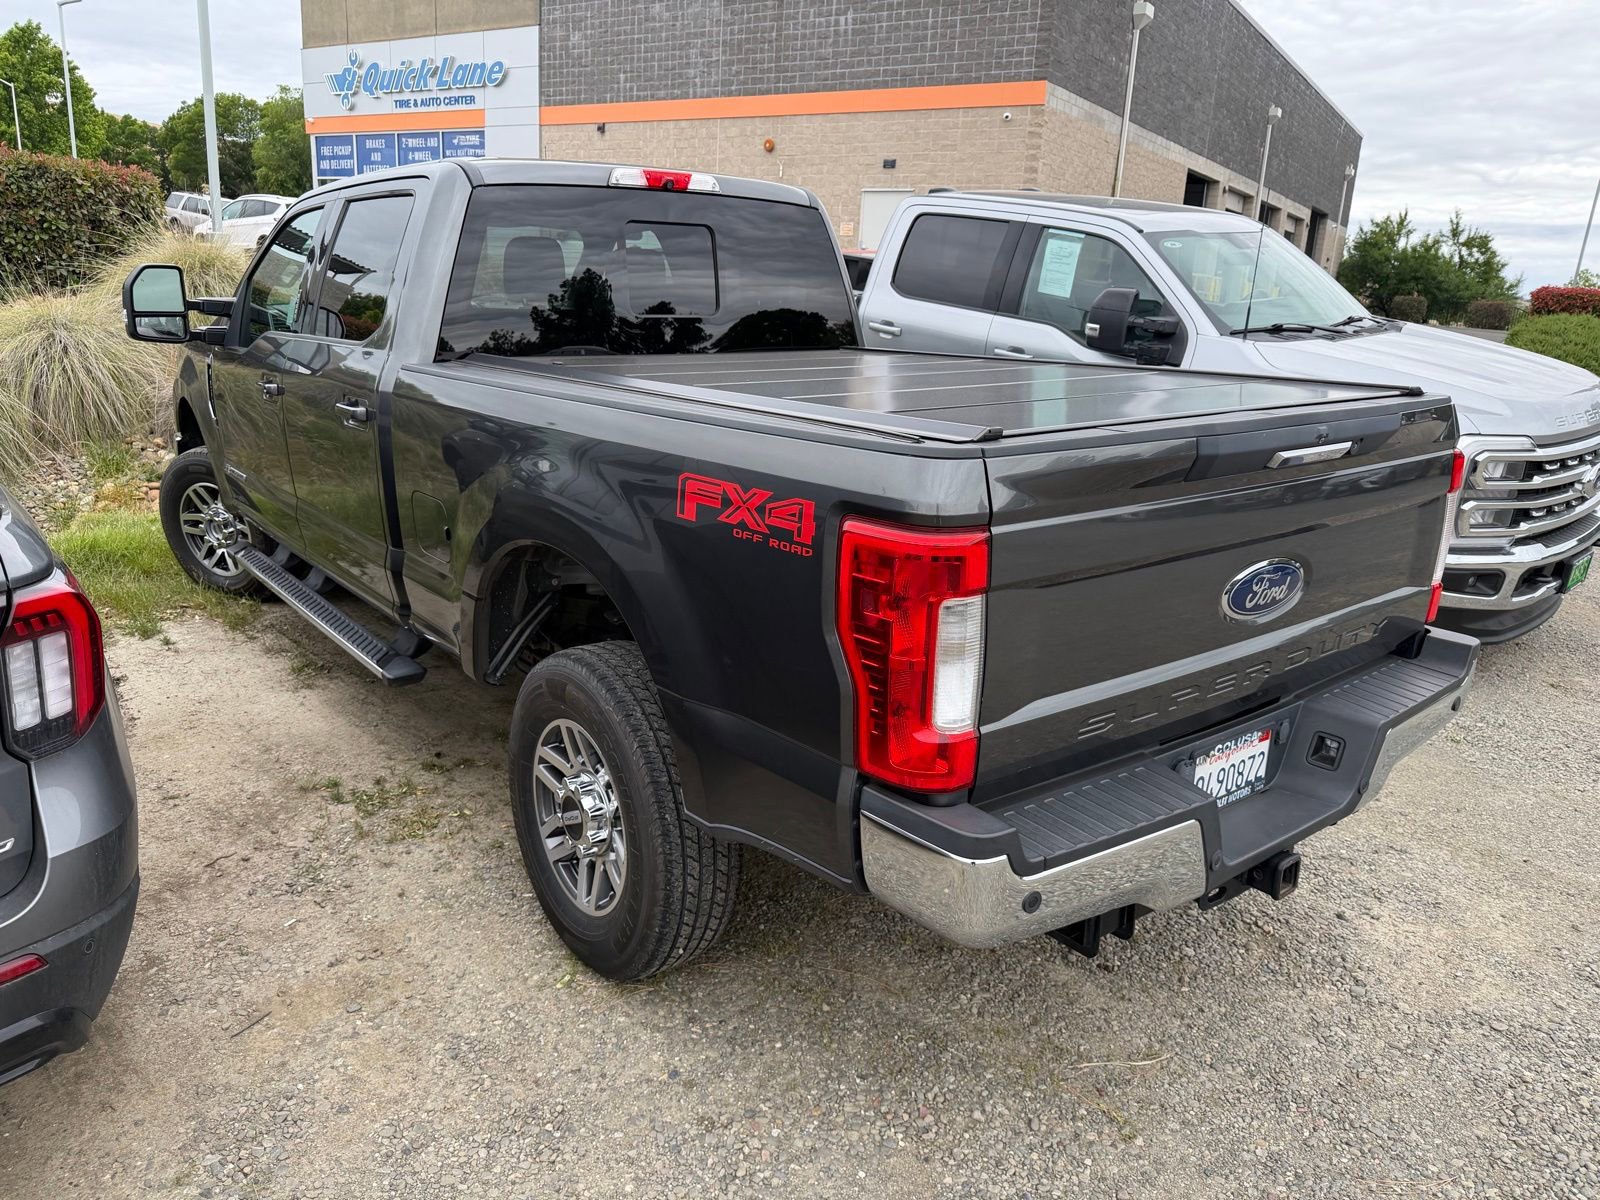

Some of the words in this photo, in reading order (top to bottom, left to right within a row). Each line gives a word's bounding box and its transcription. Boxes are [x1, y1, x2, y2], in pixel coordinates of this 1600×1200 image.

[361, 57, 435, 97] Quick
[435, 55, 505, 90] Lane
[394, 99, 411, 109] TIRE
[413, 99, 418, 108] &
[420, 97, 441, 108] AUTO
[443, 95, 476, 106] CENTER
[365, 139, 385, 149] BRAKES
[402, 138, 425, 148] 2-WHEEL
[427, 137, 438, 147] AND
[320, 146, 333, 156] FREE
[334, 145, 351, 156] PICKUP
[371, 152, 381, 161] AND
[408, 151, 432, 160] 4-WHEEL
[320, 160, 330, 170] AND
[331, 159, 353, 169] DELIVERY
[676, 472, 816, 545] FX4
[732, 528, 763, 543] OFF
[769, 538, 813, 557] ROAD
[1245, 572, 1291, 609] Ford
[1077, 660, 1272, 740] SUPER
[1215, 731, 1258, 755] COLUSA
